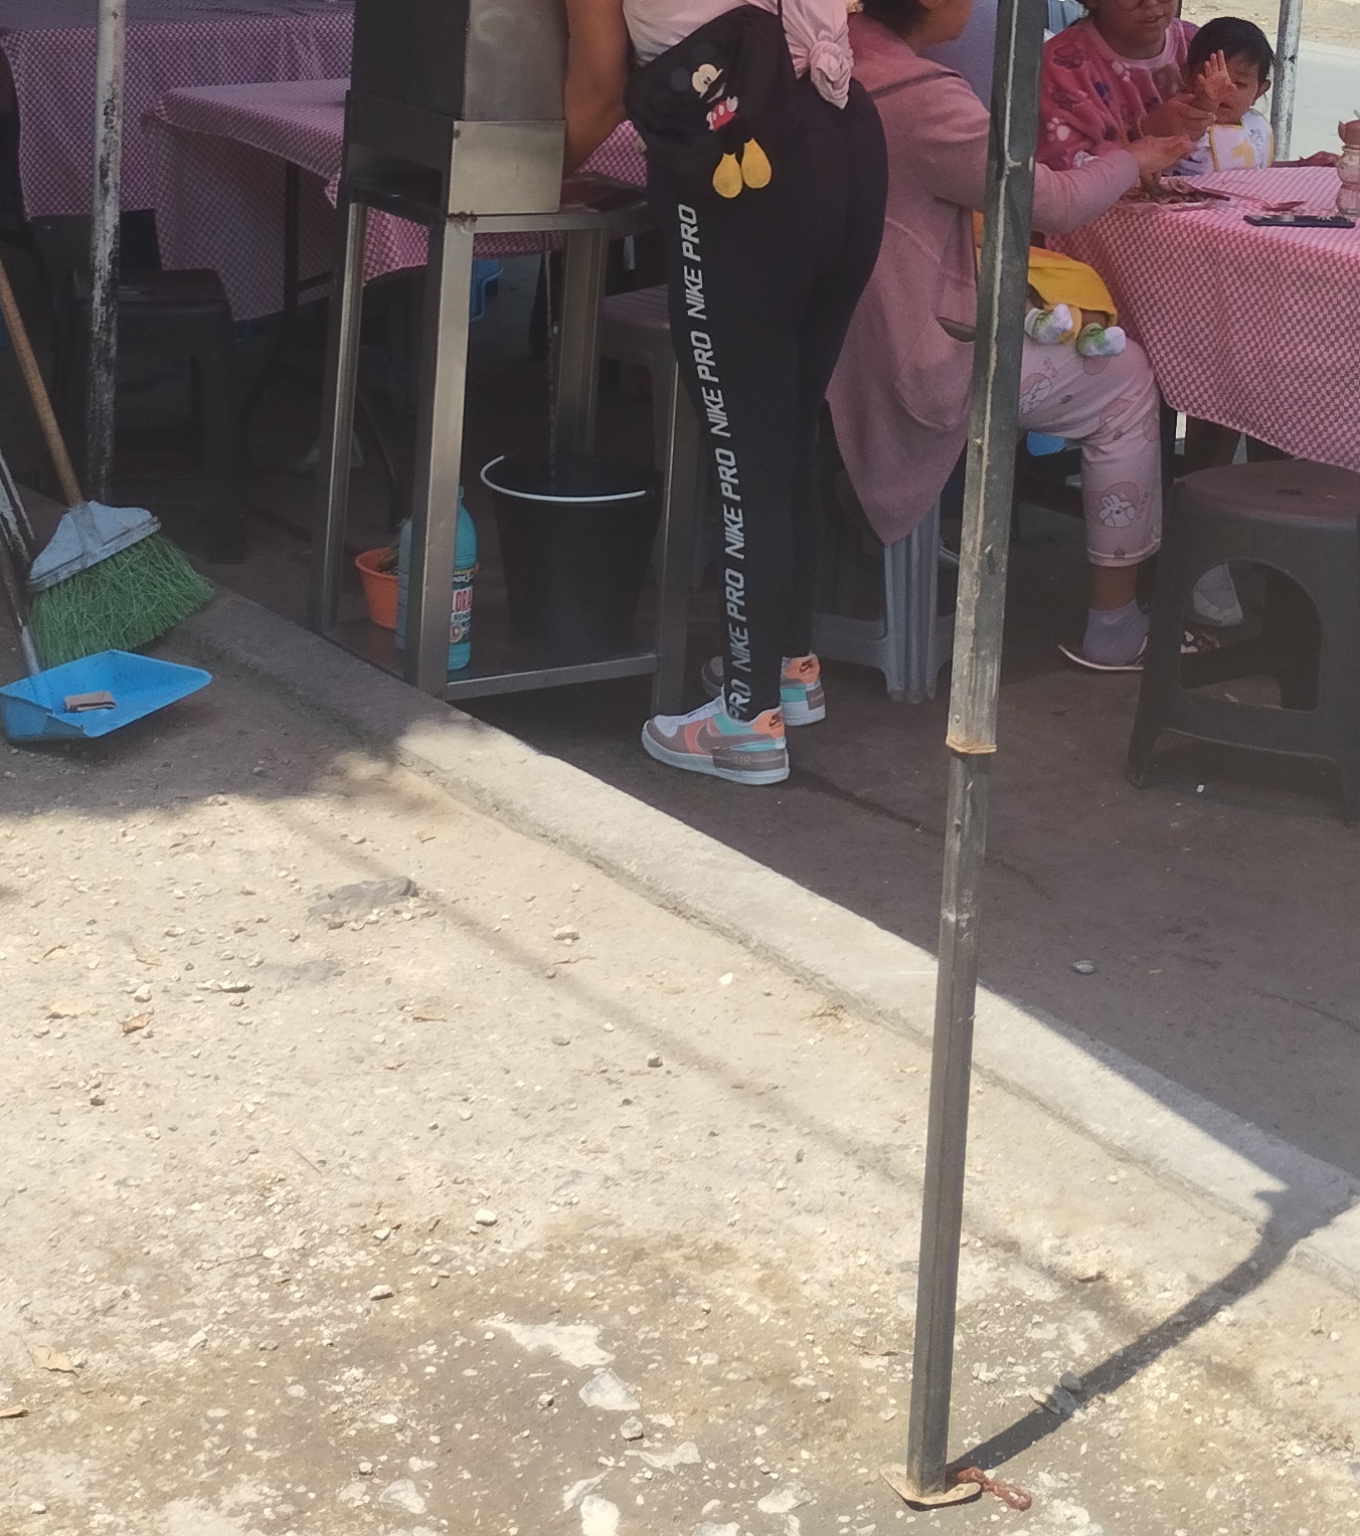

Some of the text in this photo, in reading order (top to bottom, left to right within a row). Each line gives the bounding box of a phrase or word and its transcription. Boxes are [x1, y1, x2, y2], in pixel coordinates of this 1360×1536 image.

[678, 203, 701, 262] PRO
[683, 264, 707, 321] NIKE
[690, 329, 720, 383] PRO
[701, 385, 732, 439] NIKE
[714, 446, 740, 502] PRO
[722, 503, 745, 560] NIKE
[725, 567, 747, 622] PRO
[728, 622, 752, 673] NIKE
